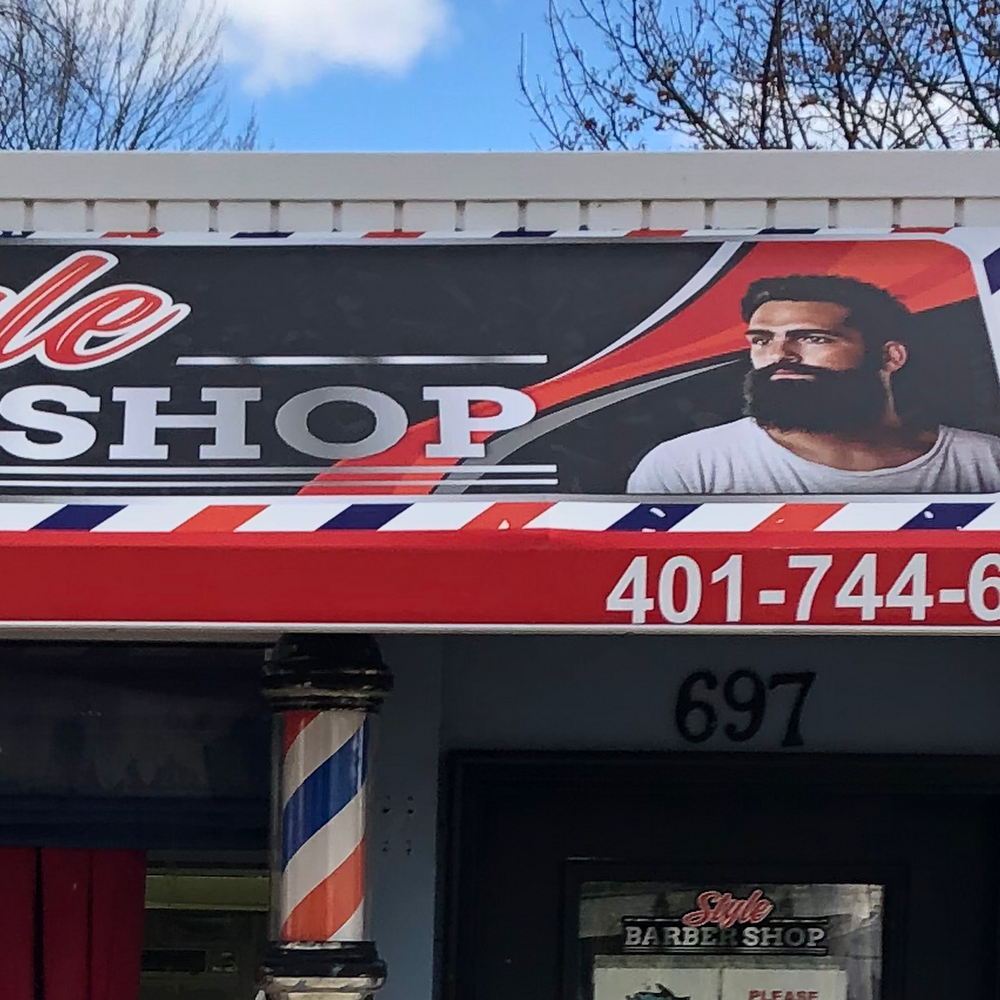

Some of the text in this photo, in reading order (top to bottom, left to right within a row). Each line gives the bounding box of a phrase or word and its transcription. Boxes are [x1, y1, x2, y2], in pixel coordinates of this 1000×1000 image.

[606, 552, 1000, 624] 401-744-6
[675, 669, 817, 747] 697
[682, 889, 774, 928] Style
[625, 926, 826, 947] BARBER SHOP
